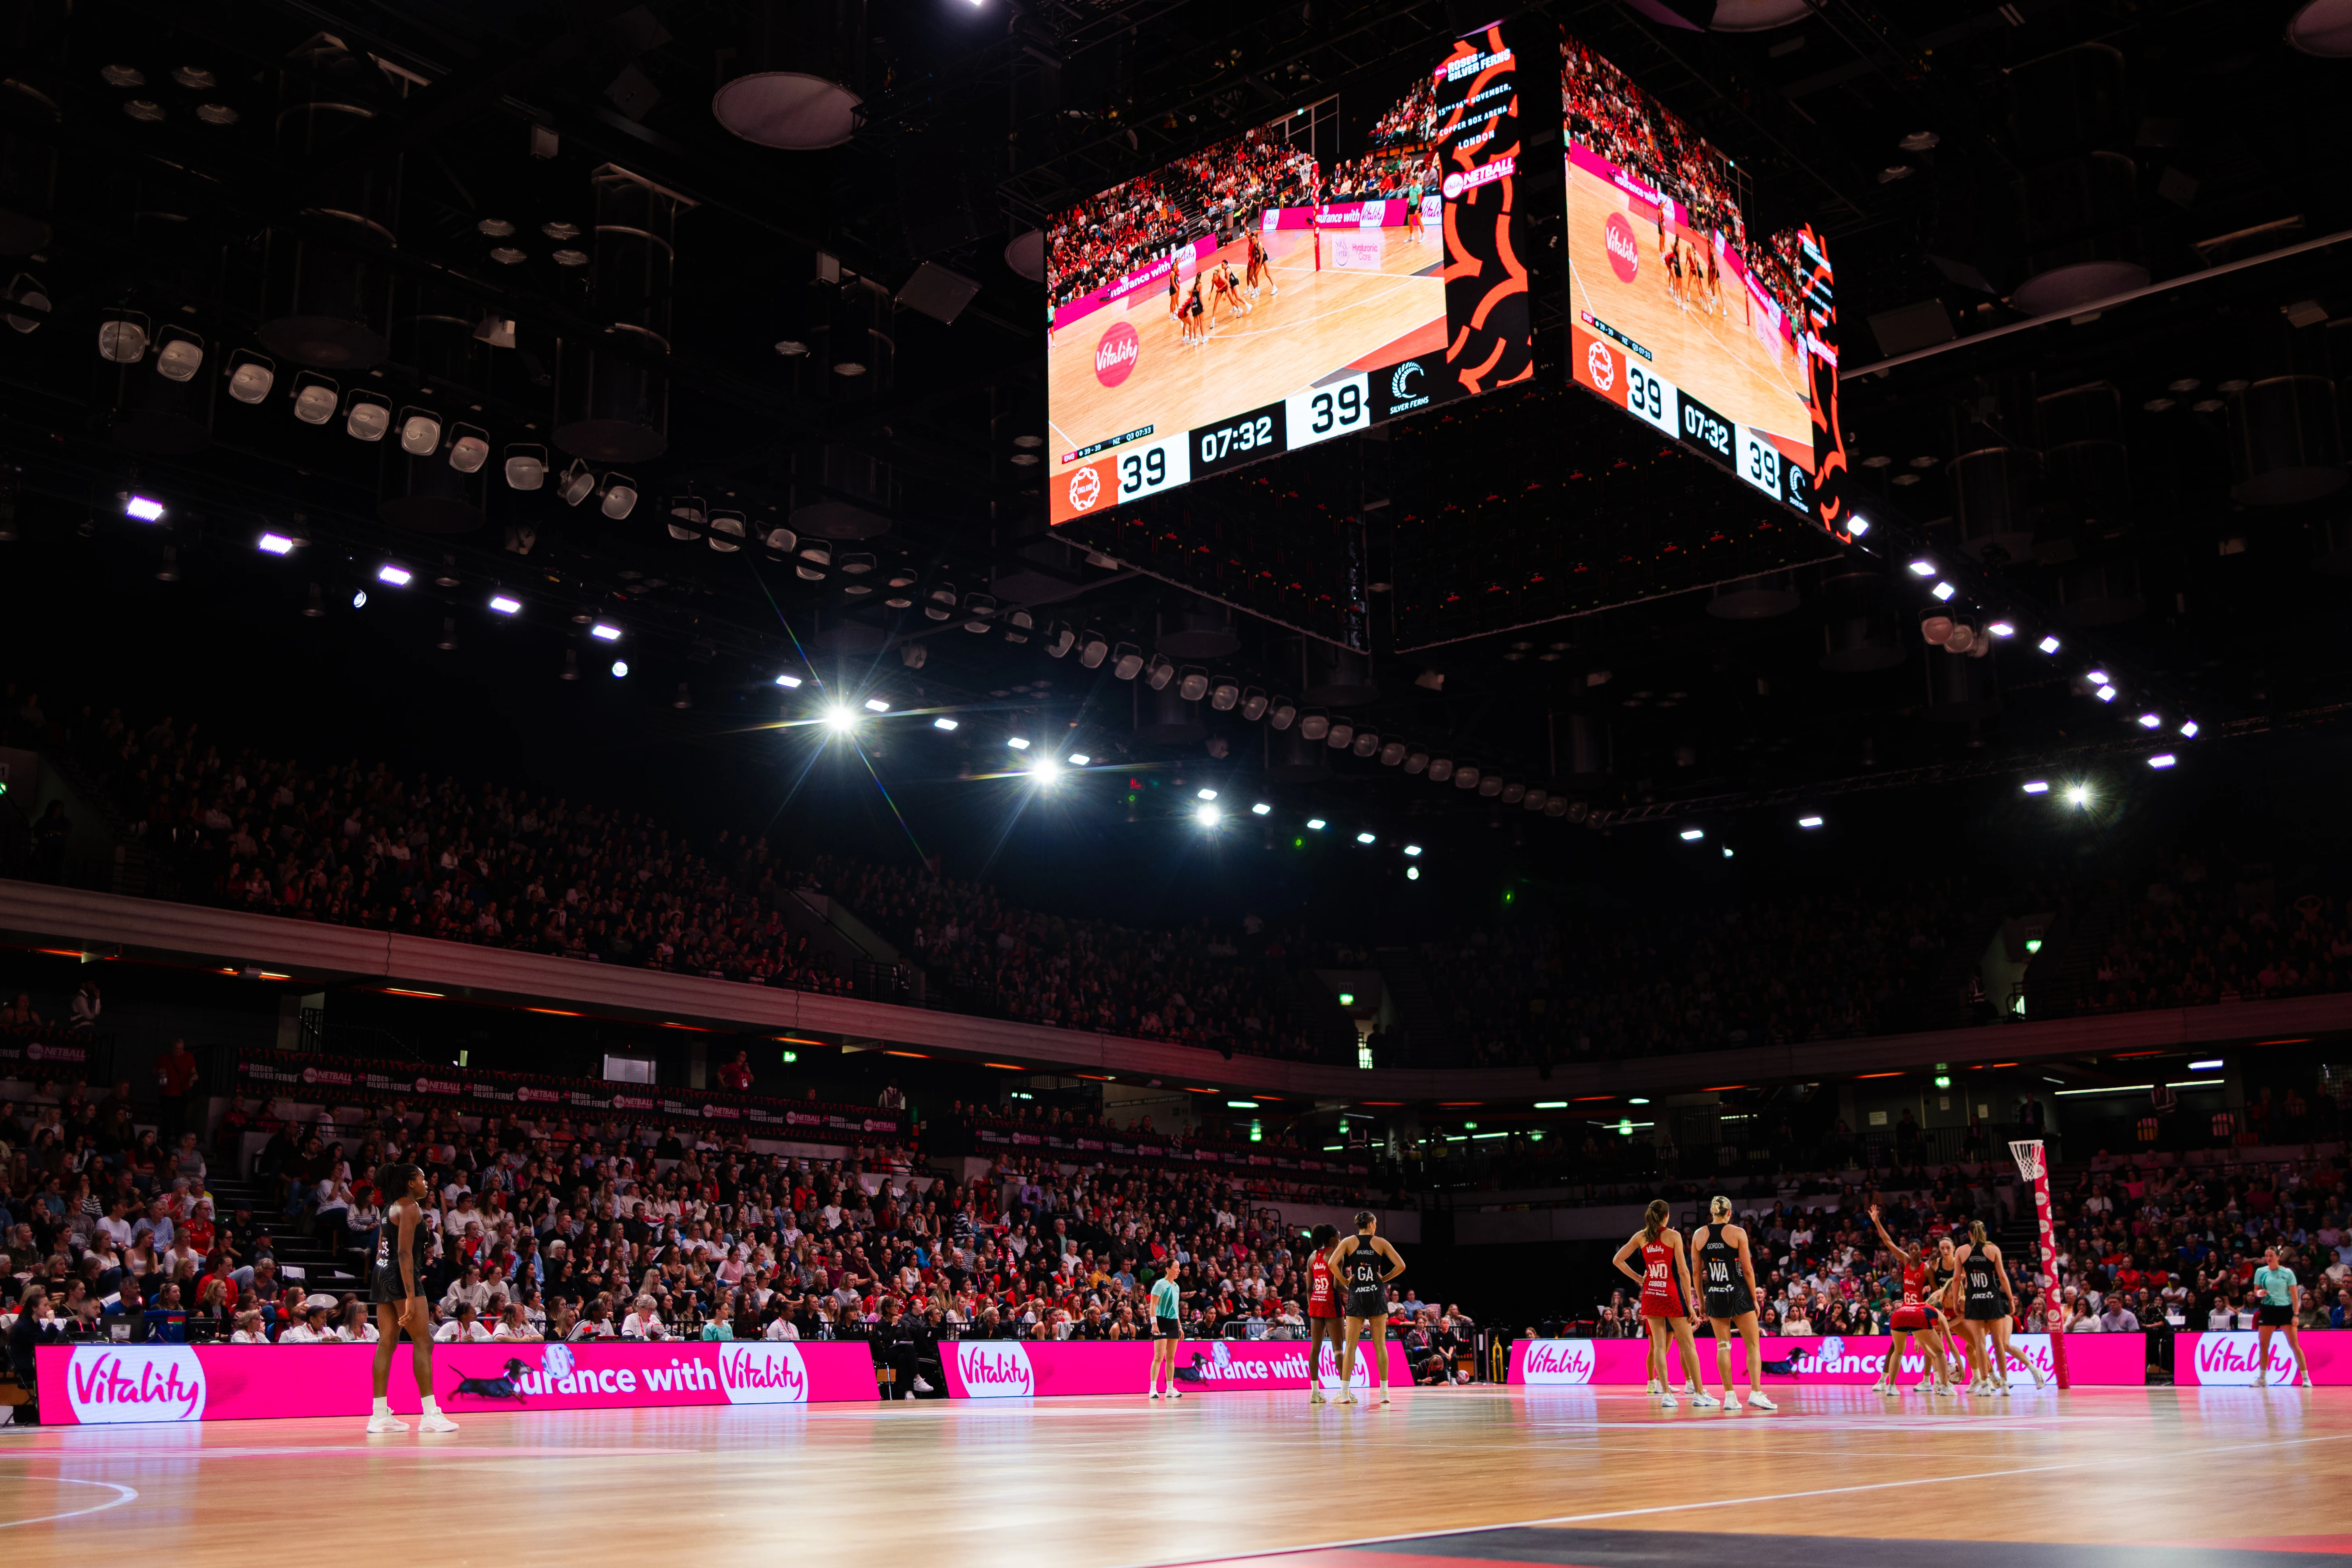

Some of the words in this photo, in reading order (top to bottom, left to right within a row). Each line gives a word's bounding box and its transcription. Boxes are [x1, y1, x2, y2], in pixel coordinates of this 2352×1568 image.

[1448, 54, 1478, 74] ROSES
[1448, 62, 1479, 82] SILVER
[1481, 48, 1511, 70] FERNS
[1439, 121, 1466, 137] COPPER
[1468, 114, 1482, 126] BOX
[1458, 130, 1495, 150] LONDON
[1463, 157, 1513, 185] NETBALL
[1344, 209, 1361, 222] with
[1361, 202, 1384, 223] Vitality
[1352, 243, 1378, 254] Hyaluronic
[1359, 252, 1371, 261] Care
[1606, 226, 1637, 271] Vitality
[1151, 261, 1171, 278] with
[1583, 313, 1592, 323] ENG
[1622, 336, 1628, 345] NZ
[1096, 338, 1138, 371] Vitality
[1631, 368, 1661, 420] 39
[1311, 384, 1361, 434] 39
[1390, 402, 1409, 415] SILVER
[1409, 396, 1429, 407] FERNS
[1685, 405, 1729, 455] 07:32
[1064, 453, 1075, 462] ENG
[1126, 432, 1134, 441] Q3
[1135, 427, 1151, 438] 07:33
[1201, 415, 1272, 463] 07:32
[1123, 447, 1166, 494] 39
[1750, 441, 1775, 489] 39
[1077, 483, 1093, 494] ENGLAND
[45, 1047, 86, 1058] NETBALL
[249, 1063, 273, 1072] ROSES
[249, 1072, 274, 1080] SILVER
[275, 1073, 297, 1082] FERNS
[317, 1072, 352, 1082] NETBALL
[367, 1074, 389, 1082] ROSES
[390, 1083, 411, 1092] FERNS
[428, 1081, 461, 1091] NETBALL
[474, 1084, 493, 1092] ROSES
[529, 1090, 559, 1099] NETBALL
[495, 1092, 513, 1101] FERNS
[625, 1098, 653, 1106] NETBALL
[683, 1108, 699, 1117] FERNS
[714, 1107, 740, 1115] NETBALL
[1646, 1244, 1664, 1254] Vitality
[1313, 1262, 1326, 1271] Vitality
[1357, 1267, 1374, 1281] GA
[1648, 1263, 1668, 1279] WD
[1709, 1262, 1729, 1281] WA
[1315, 1277, 1329, 1290] GD
[1970, 1273, 1988, 1288] WD
[1904, 1292, 1917, 1304] GS
[960, 1347, 1029, 1394] Vitality
[1269, 1352, 1310, 1378] with
[1529, 1344, 1590, 1383] Vitality
[642, 1358, 716, 1391] with
[722, 1347, 803, 1401] Vitality
[75, 1352, 198, 1418] Vitality
